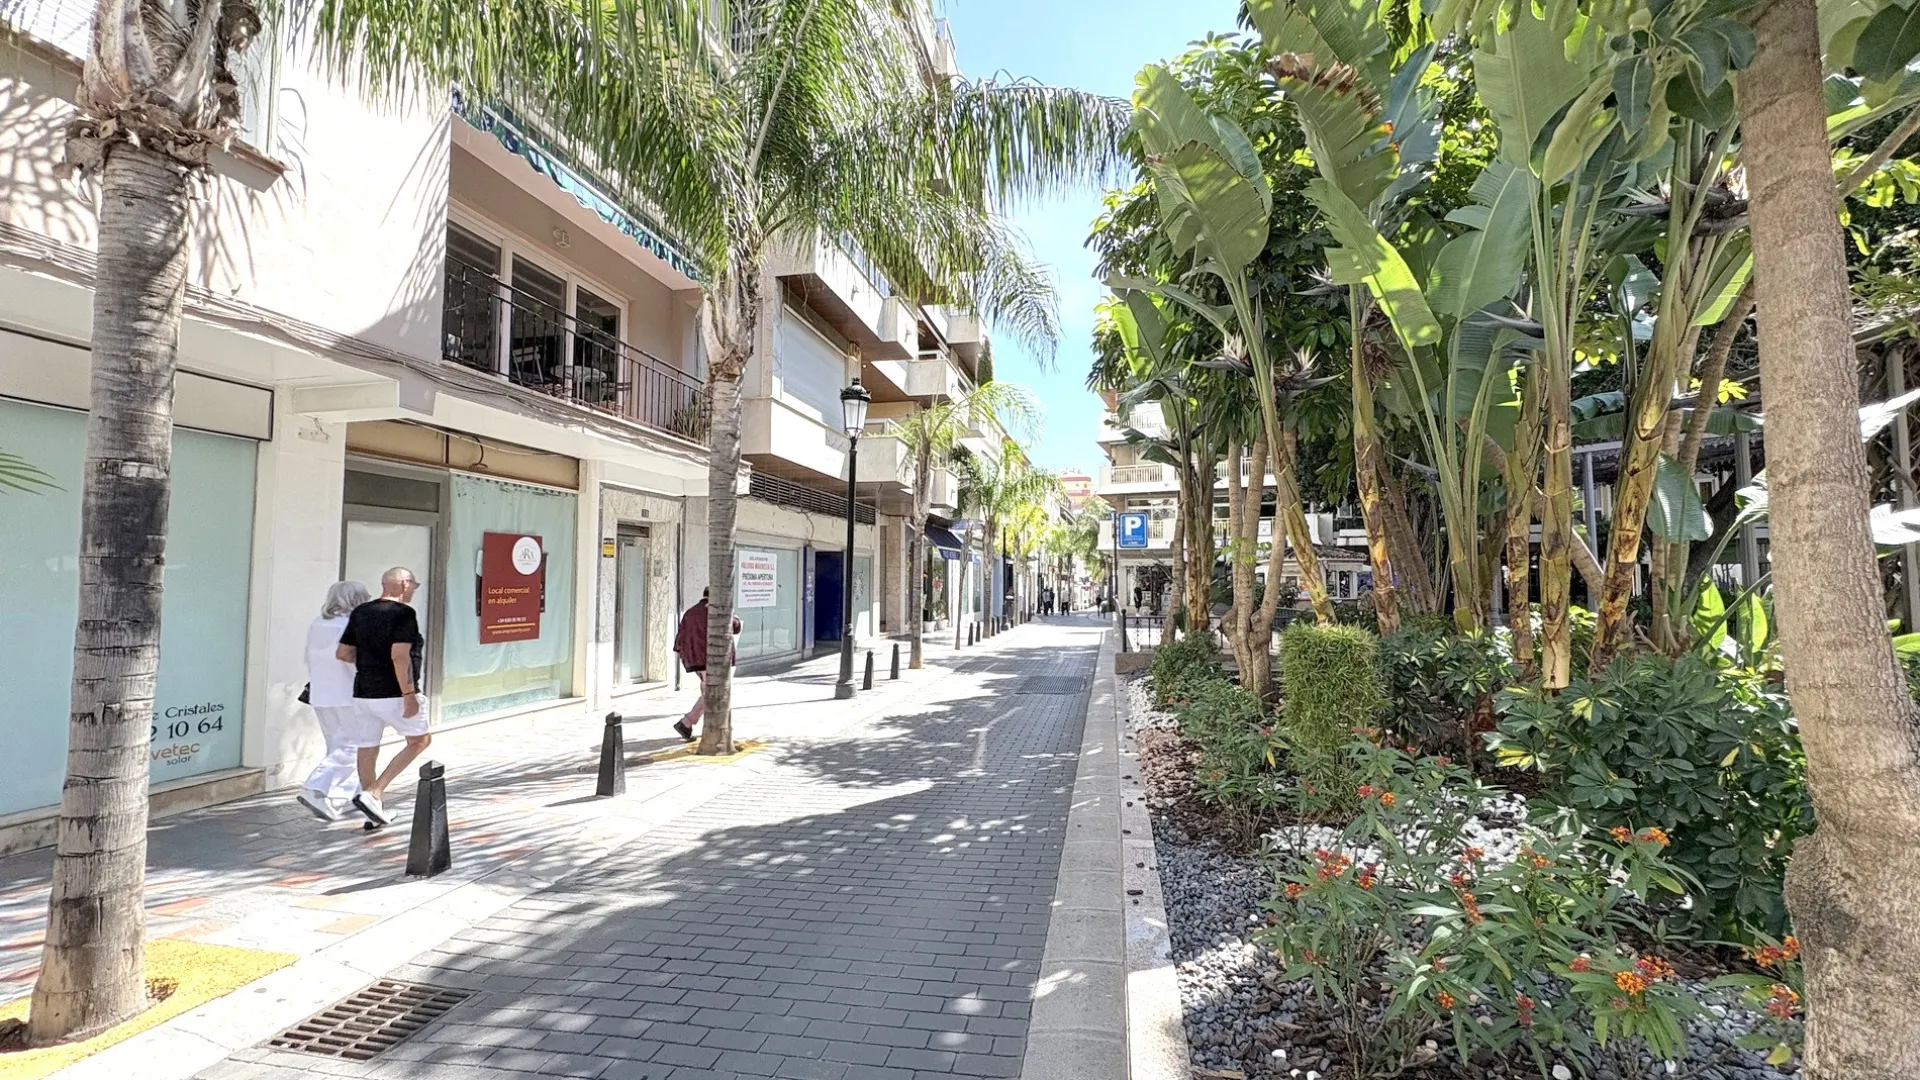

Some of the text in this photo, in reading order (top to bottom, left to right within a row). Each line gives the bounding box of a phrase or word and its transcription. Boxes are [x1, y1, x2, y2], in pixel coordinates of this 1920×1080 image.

[1125, 516, 1142, 536] P
[496, 596, 517, 605] alquiler
[165, 702, 225, 718] Cristales
[167, 720, 189, 739] 10
[197, 715, 223, 734] 64
[166, 756, 192, 766] solar
